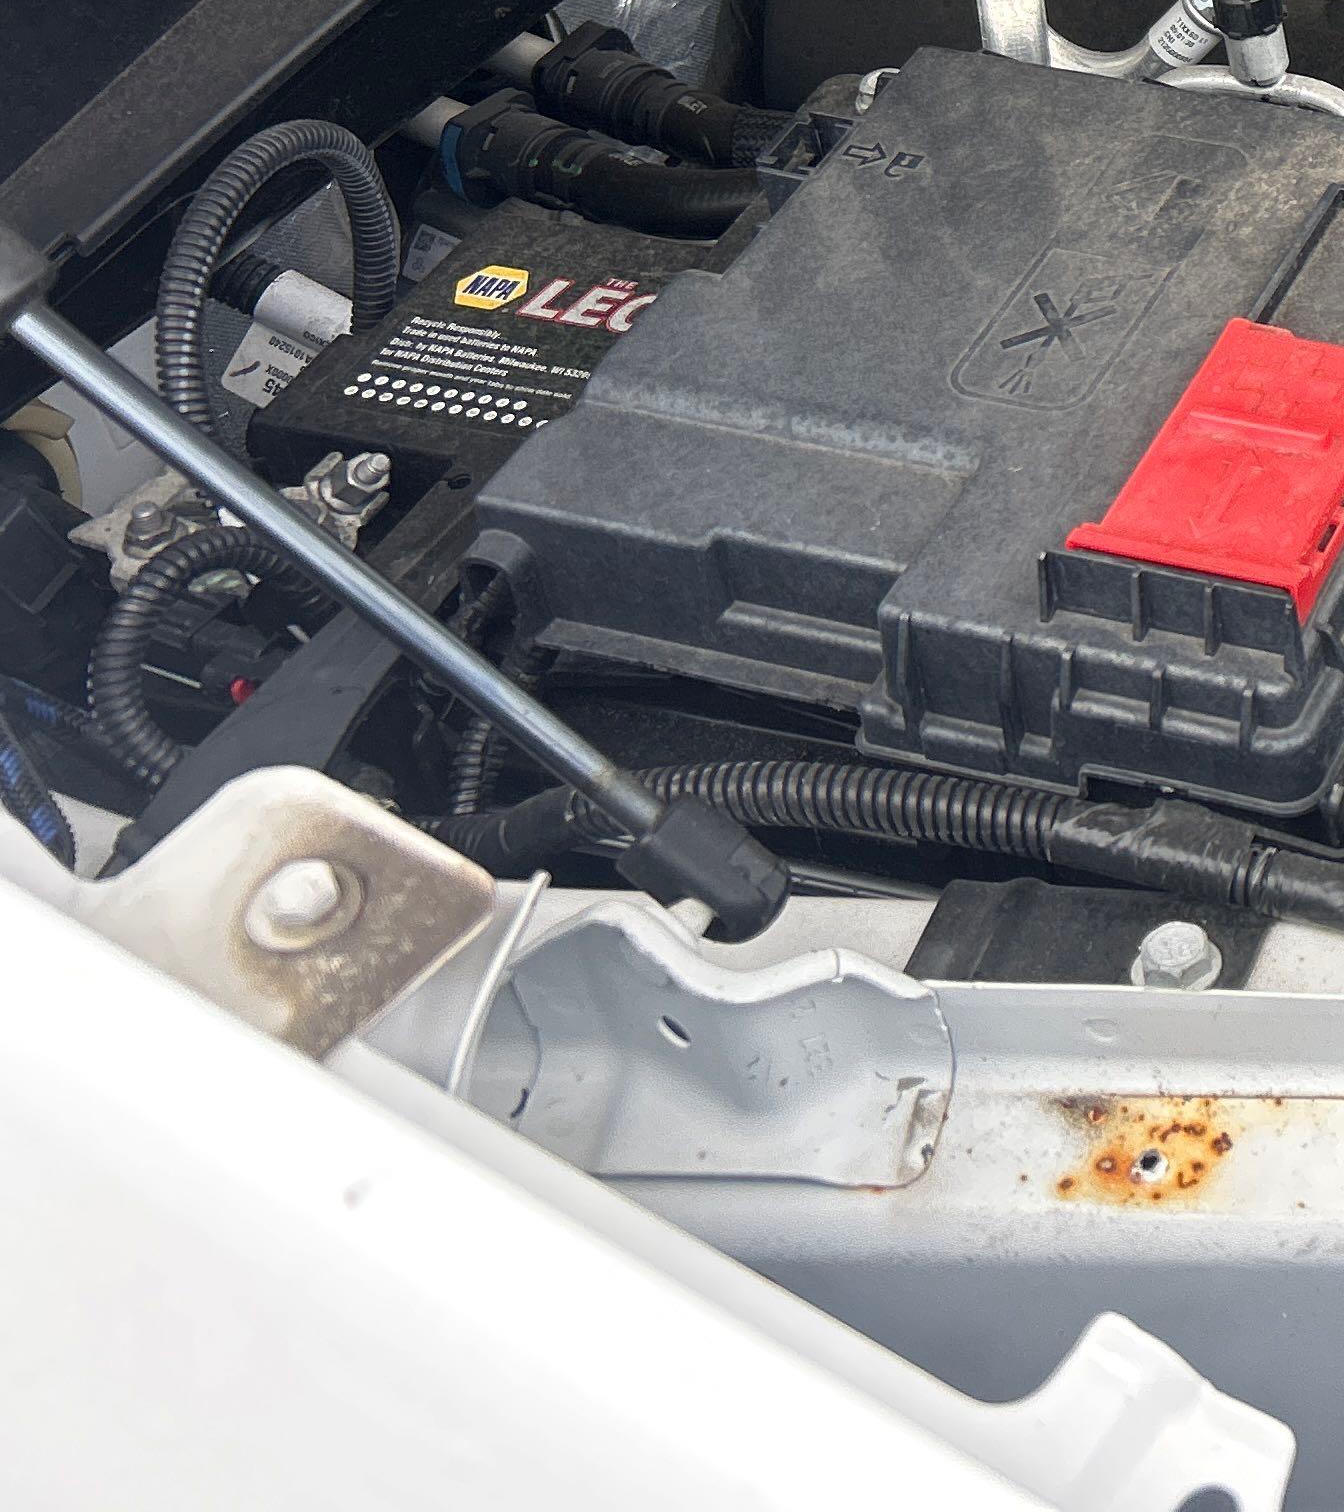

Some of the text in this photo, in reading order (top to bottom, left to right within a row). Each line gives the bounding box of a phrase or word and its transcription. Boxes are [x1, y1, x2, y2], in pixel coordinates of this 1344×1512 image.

[462, 275, 521, 301] NAPA
[606, 277, 640, 290] THE
[410, 316, 447, 329] Recycle
[402, 326, 428, 337] Trade
[427, 344, 455, 355] NAPA
[393, 350, 421, 361] NAPA
[420, 354, 474, 371] Distribution
[473, 364, 509, 377] Centers
